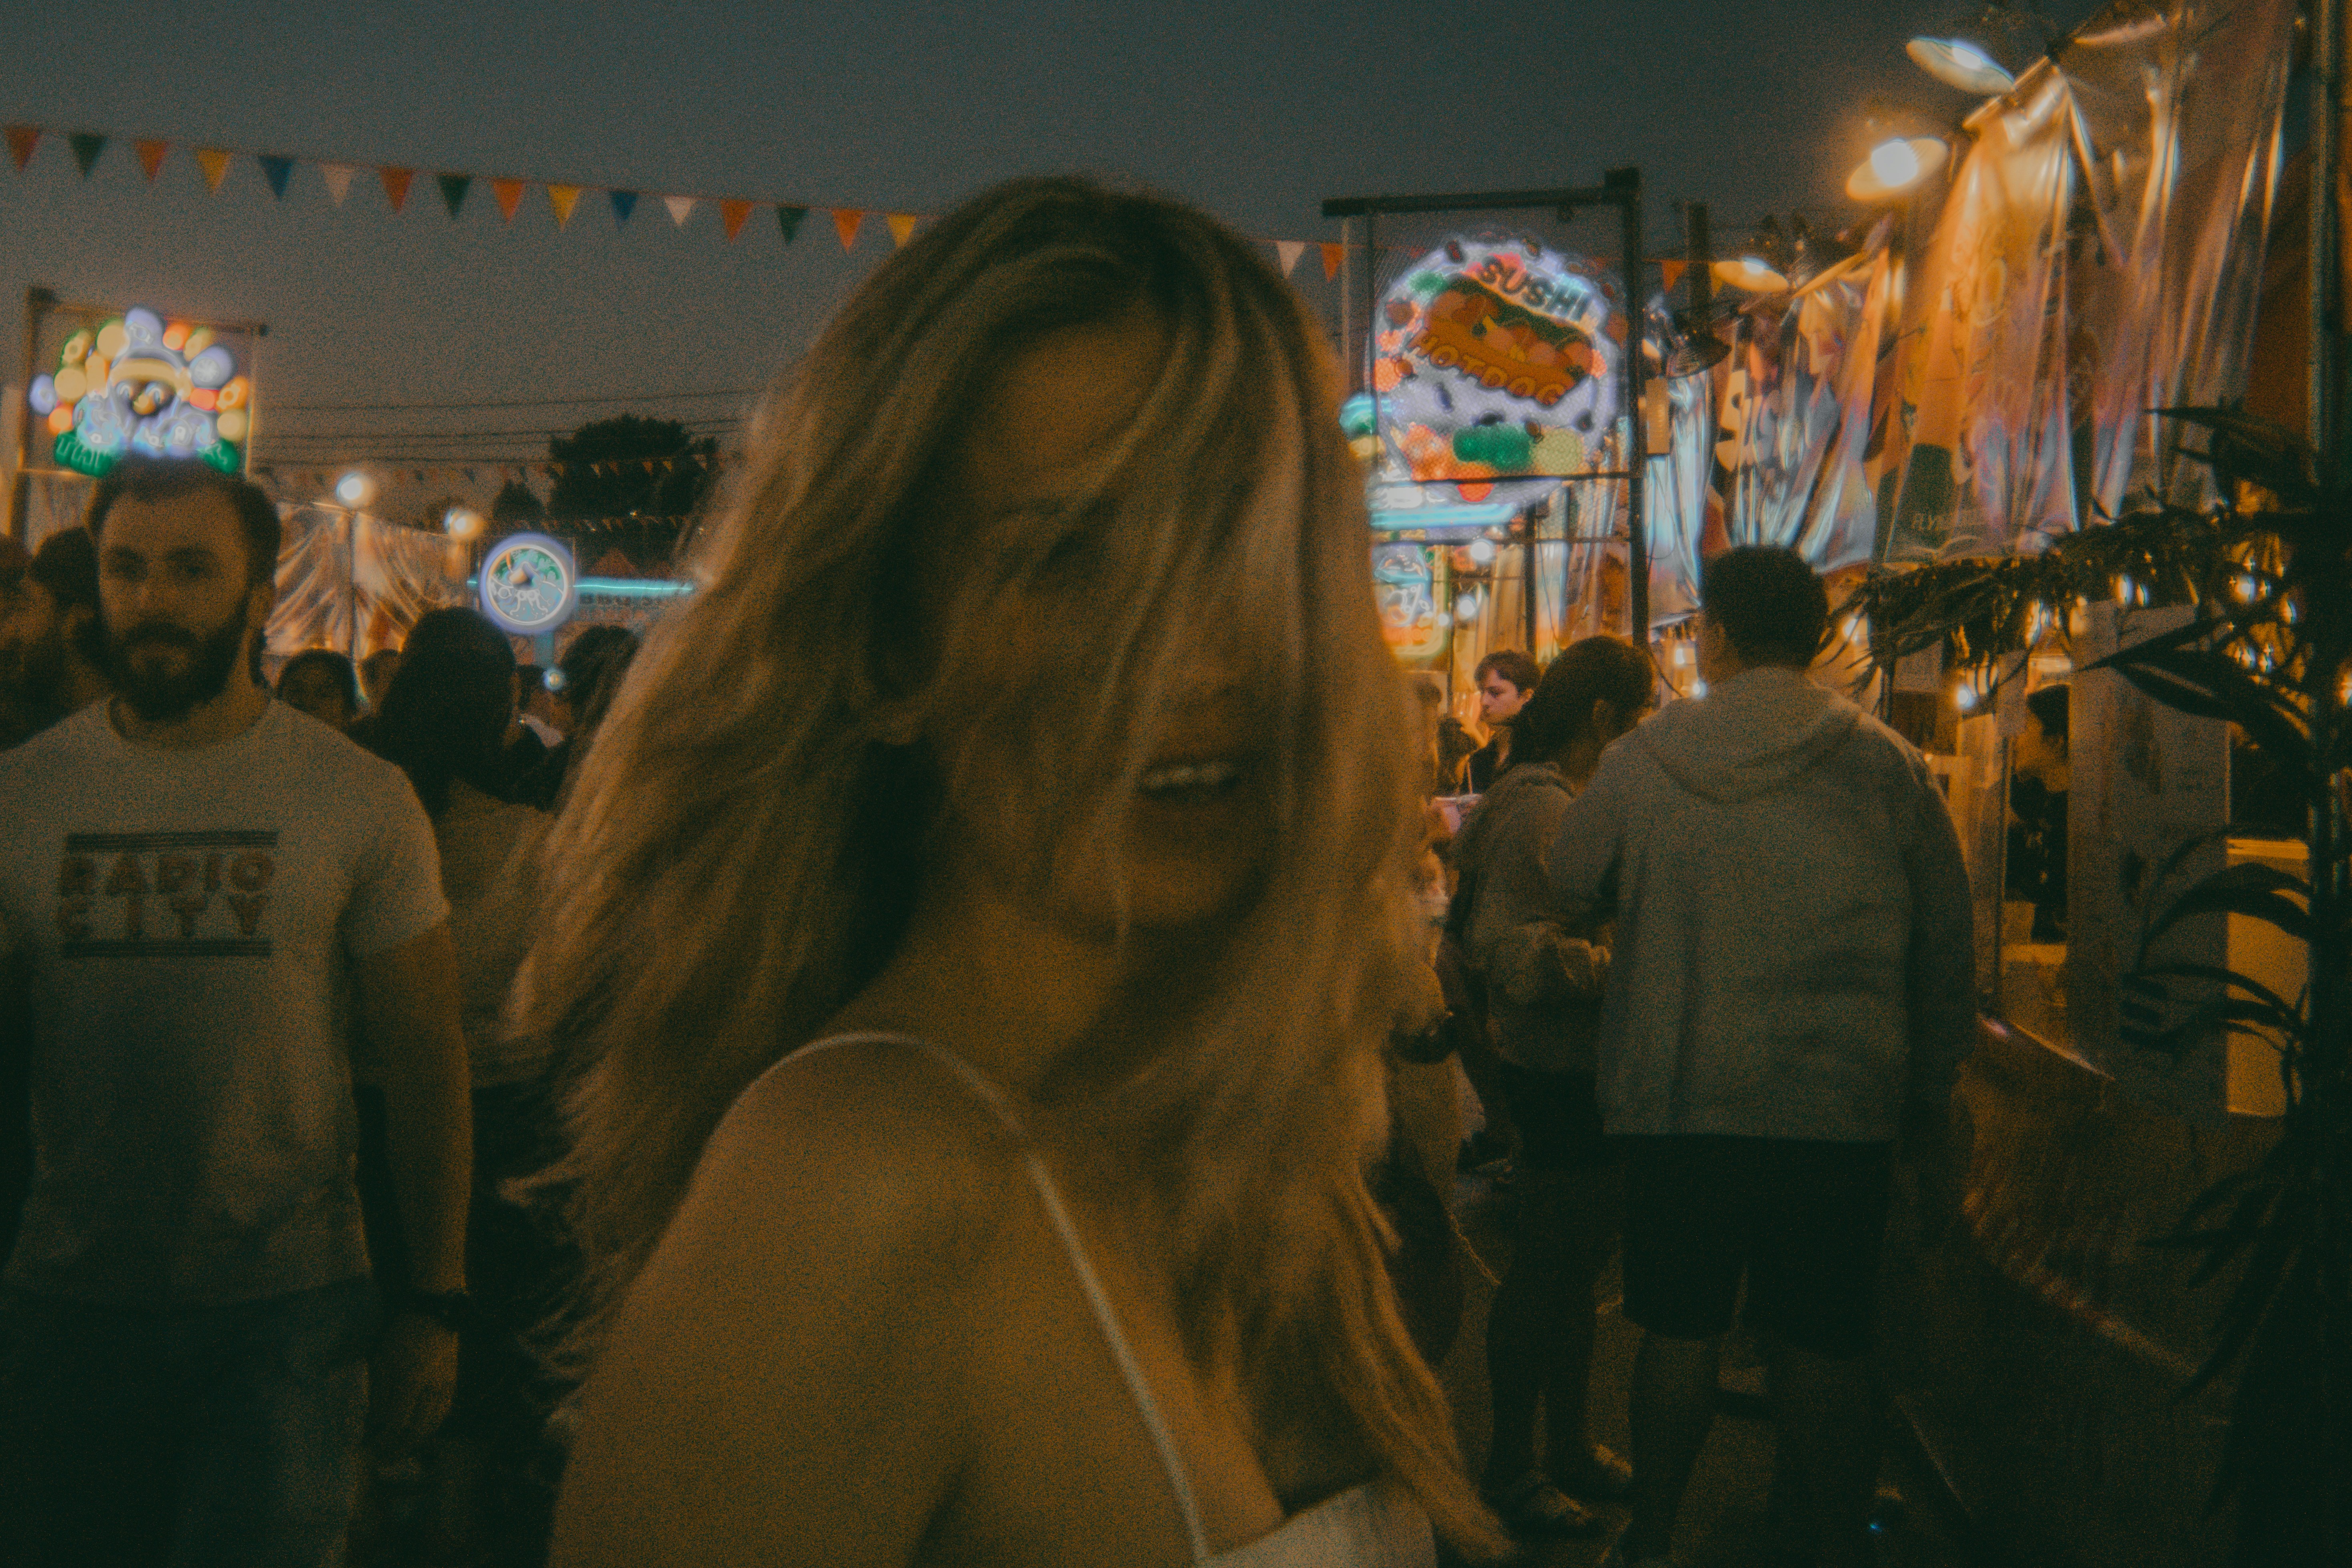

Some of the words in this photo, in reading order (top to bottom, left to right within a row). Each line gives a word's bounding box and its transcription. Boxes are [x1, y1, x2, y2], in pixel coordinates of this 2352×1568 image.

[1479, 256, 1593, 320] SUSHI
[58, 851, 276, 895] RADIO
[57, 894, 270, 939] CITY
